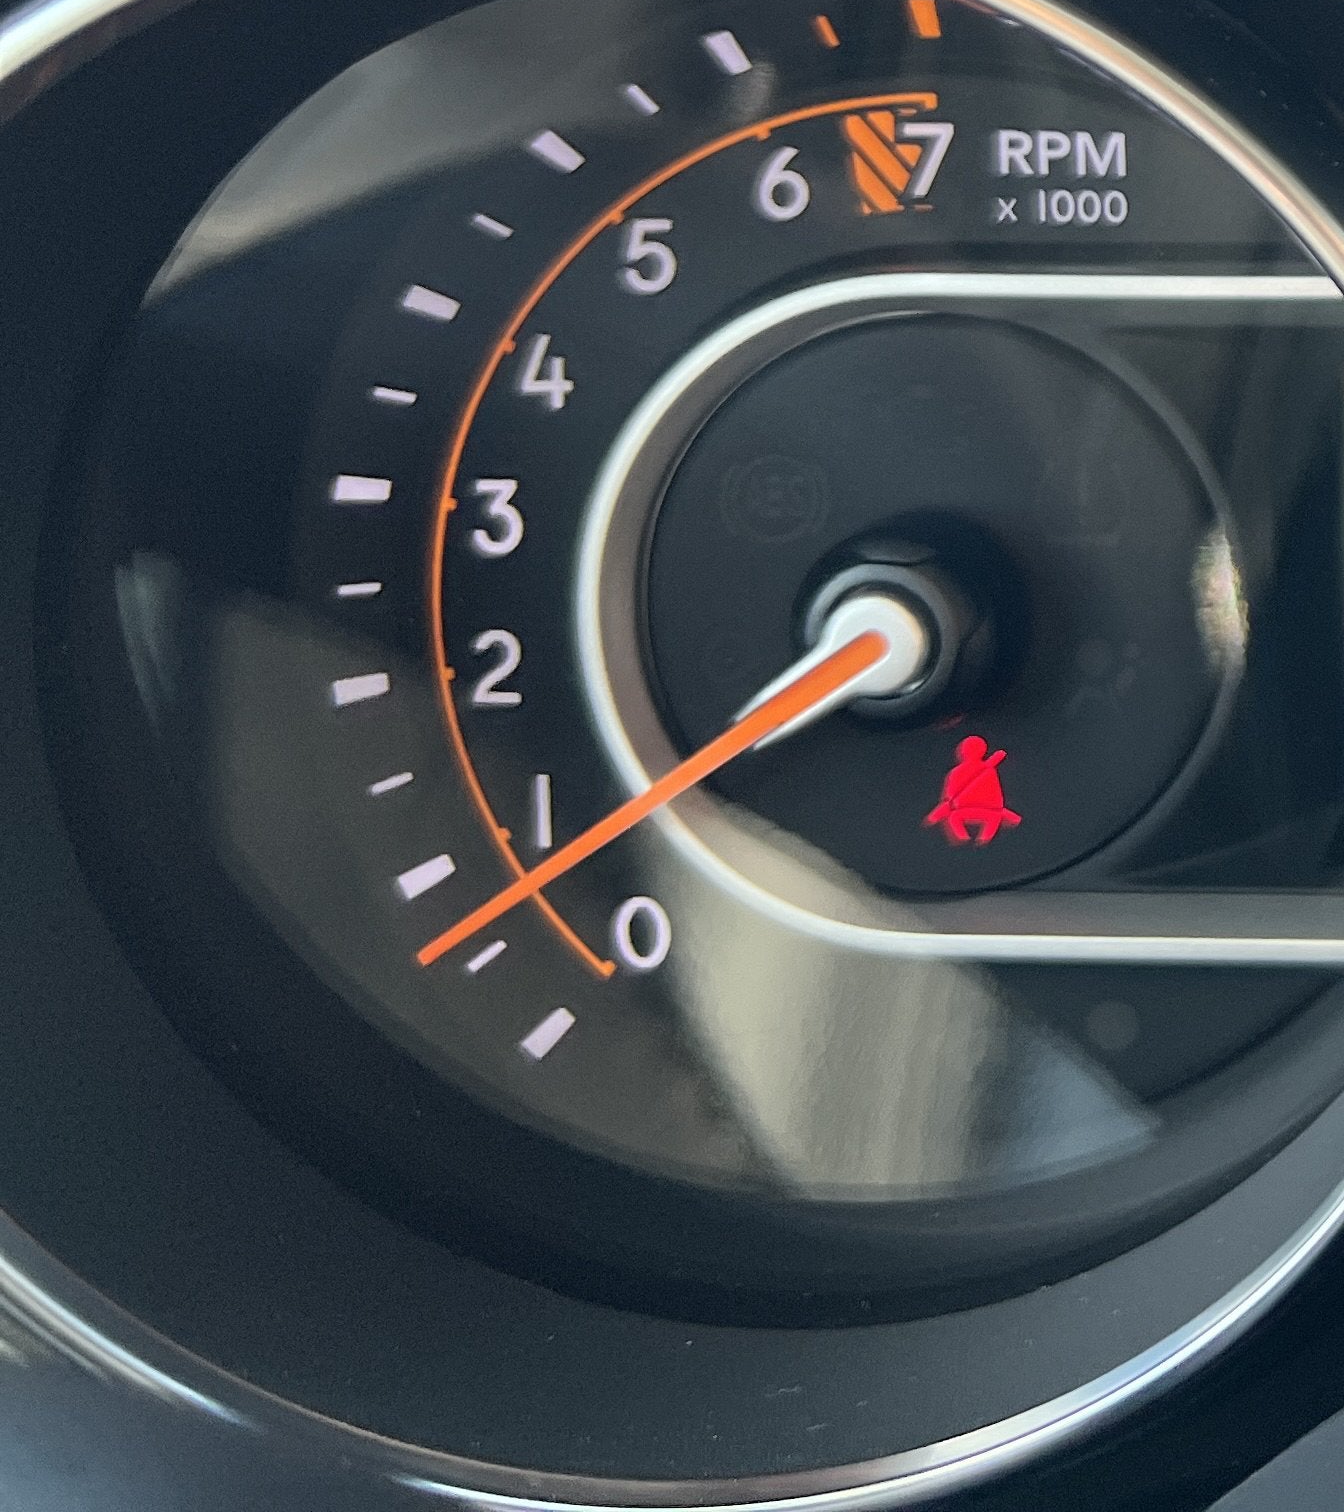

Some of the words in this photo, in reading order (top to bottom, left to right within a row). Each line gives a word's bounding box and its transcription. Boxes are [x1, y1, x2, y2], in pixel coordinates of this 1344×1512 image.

[758, 147, 809, 220] 6
[902, 123, 954, 197] 7
[998, 130, 1126, 176] RPM
[1039, 189, 1127, 223] 1000
[625, 219, 676, 294] 5
[521, 335, 573, 410] 4
[473, 479, 523, 556] 3
[472, 630, 521, 704] 2
[536, 774, 551, 849] 1
[615, 897, 671, 969] 0
